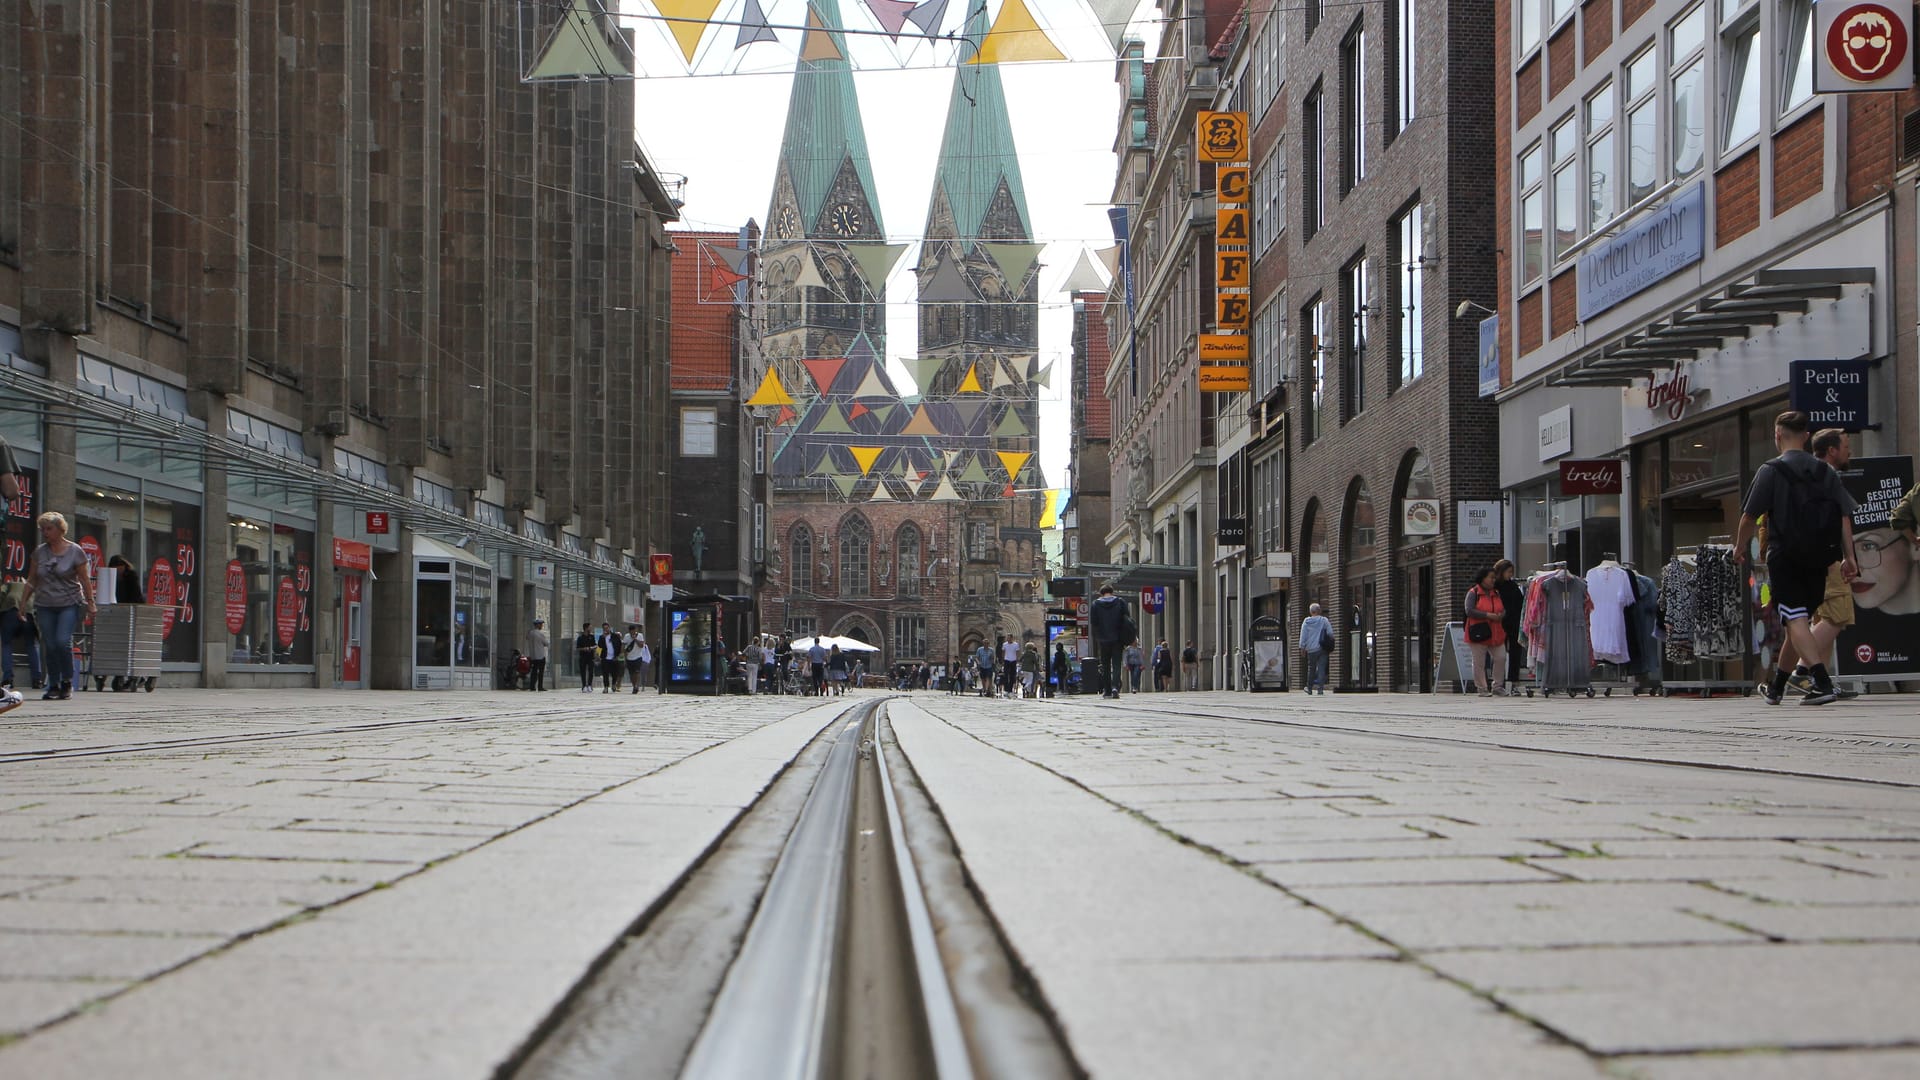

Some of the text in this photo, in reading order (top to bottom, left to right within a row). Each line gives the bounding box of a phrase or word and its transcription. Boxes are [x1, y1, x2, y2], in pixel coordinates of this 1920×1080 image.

[1219, 170, 1247, 324] CAFÉ
[1587, 241, 1630, 294] Perlen
[1648, 203, 1687, 259] mehr
[1804, 368, 1860, 385] Perlen
[1647, 361, 1692, 420] tredy
[1825, 387, 1839, 403] &
[1809, 406, 1856, 422] mehr
[1566, 466, 1614, 488] tredy
[1880, 477, 1902, 489] DEIN
[1866, 487, 1903, 502] GESICHT
[8, 498, 31, 519] ALE
[1468, 509, 1487, 518] HELLO
[1853, 511, 1891, 525] GESCHIC
[1221, 528, 1244, 536] zero
[5, 539, 26, 571] 70
[176, 543, 195, 576] 50
[296, 563, 310, 592] 50
[176, 580, 194, 623] %
[1144, 591, 1163, 605] P&C
[297, 596, 310, 632] %
